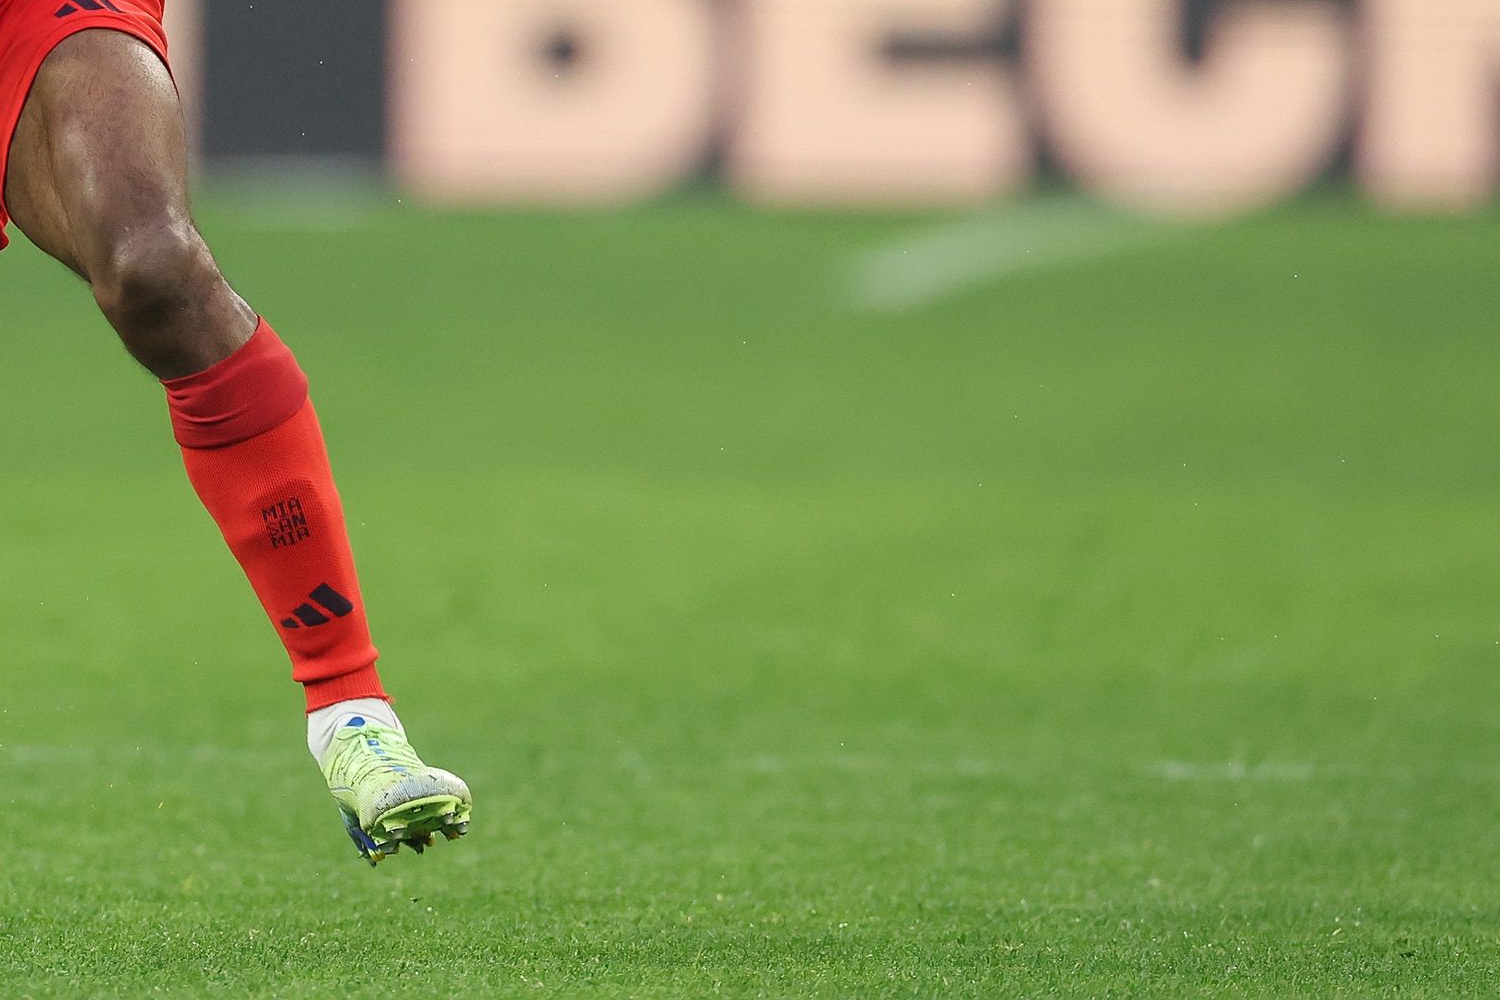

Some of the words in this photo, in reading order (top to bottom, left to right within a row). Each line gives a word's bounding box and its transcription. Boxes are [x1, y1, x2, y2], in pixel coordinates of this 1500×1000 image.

[261, 496, 302, 521] MIA
[266, 514, 308, 537] SAN
[269, 527, 311, 550] MIA
